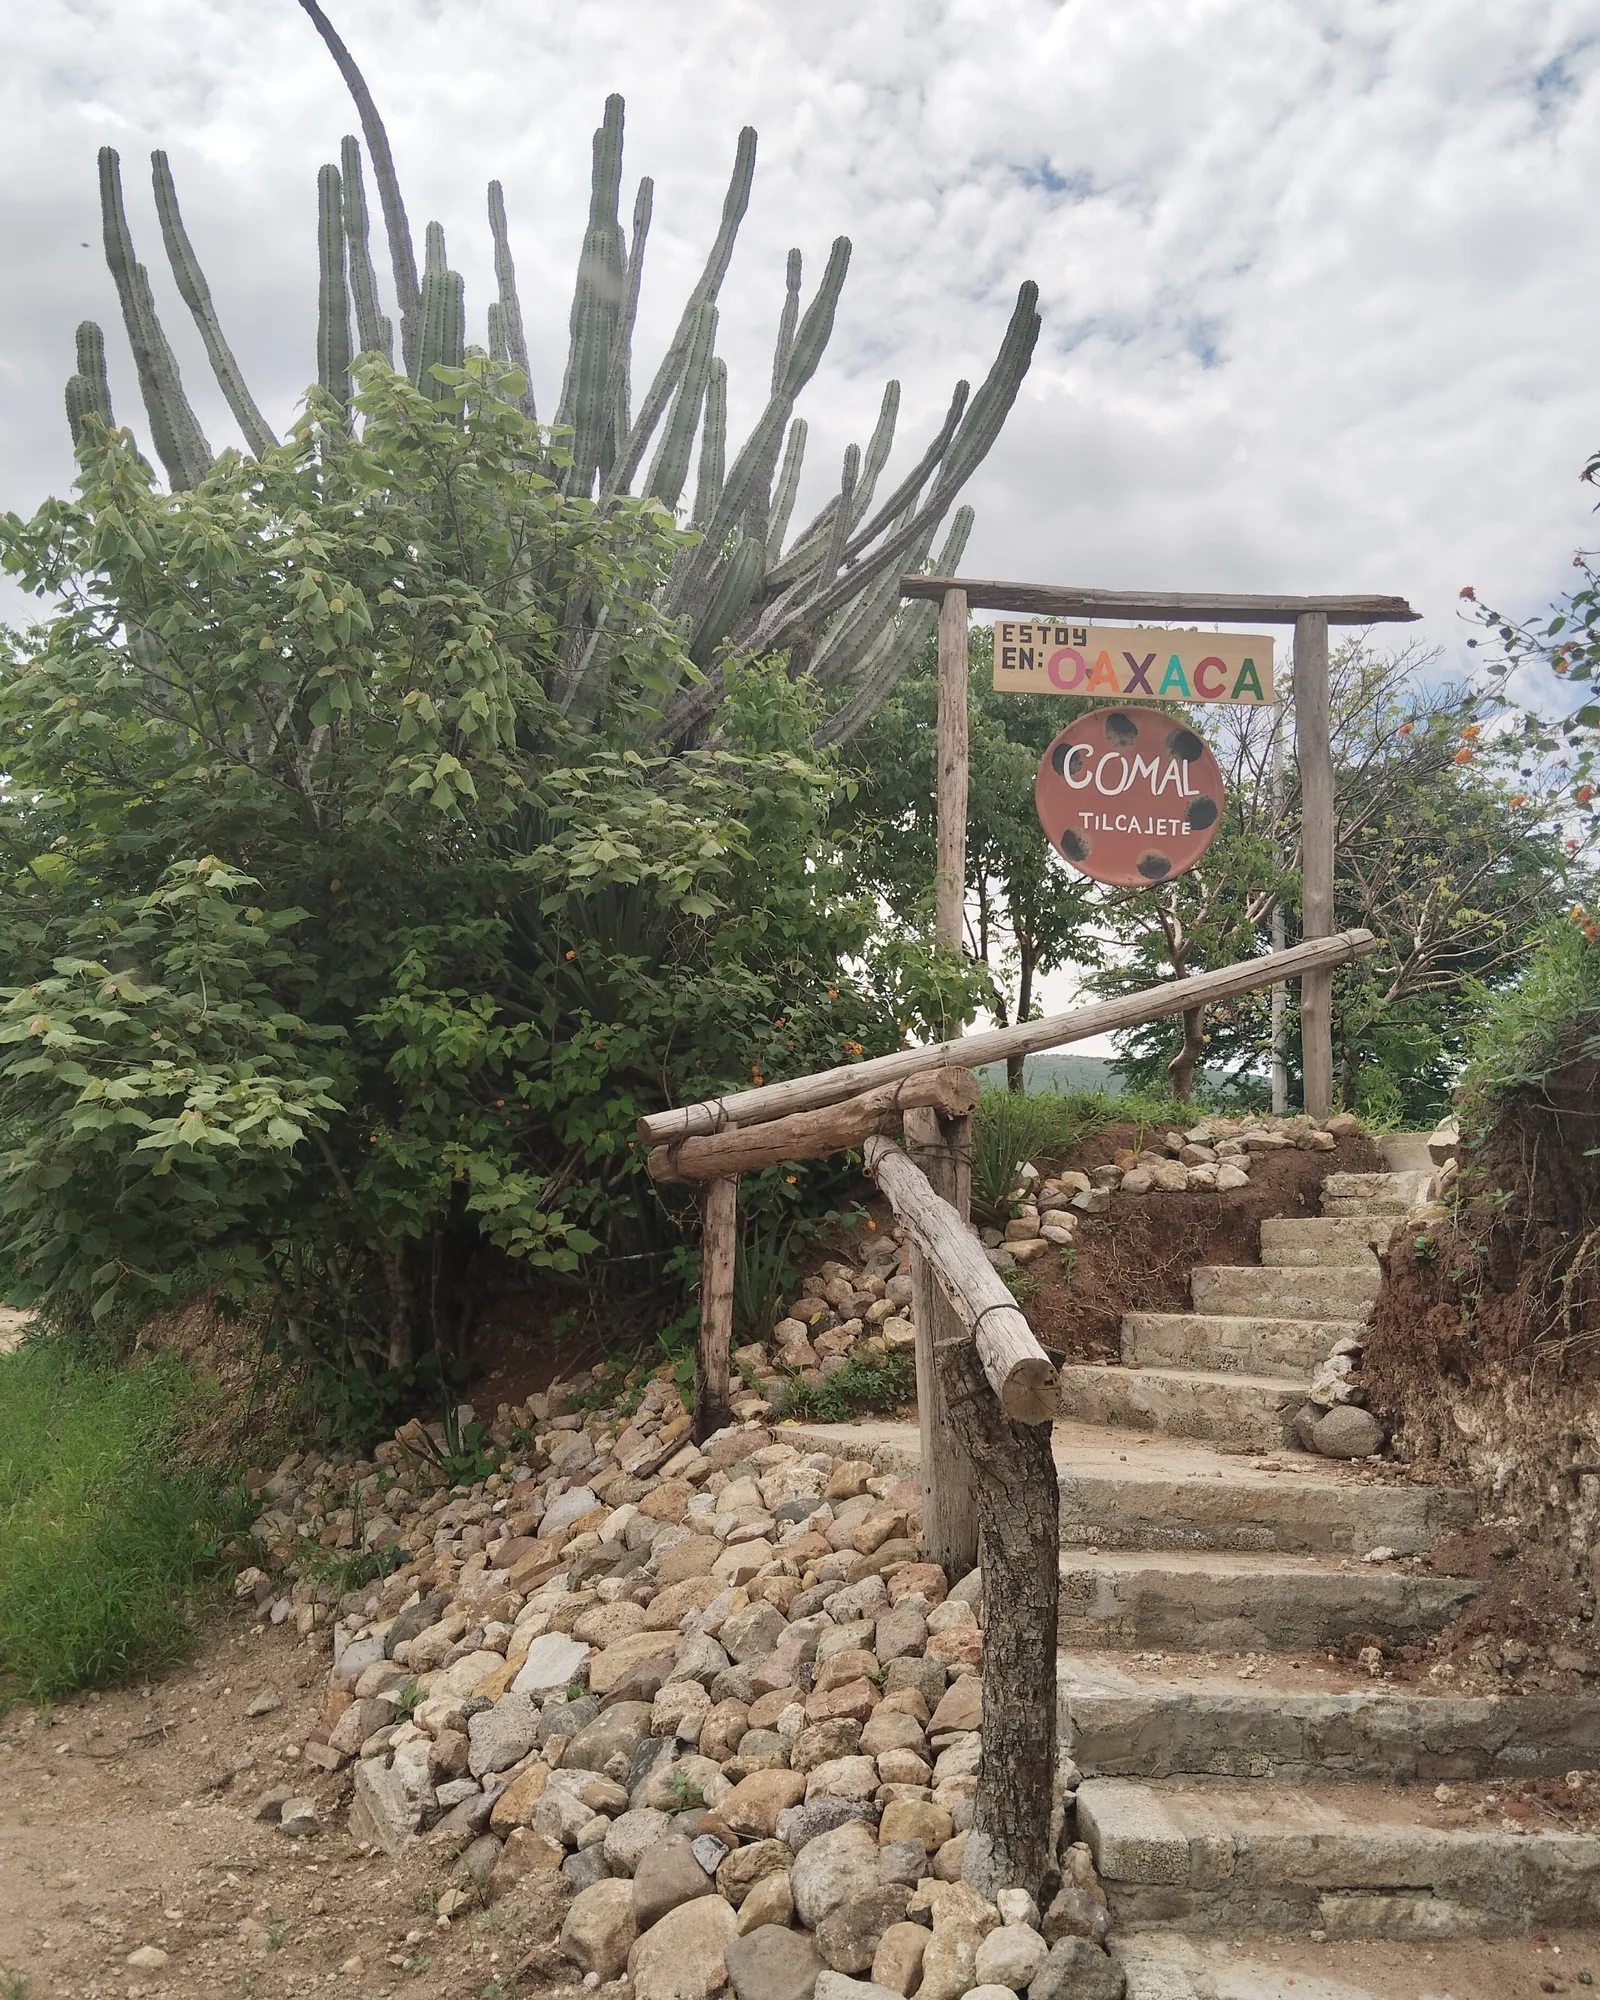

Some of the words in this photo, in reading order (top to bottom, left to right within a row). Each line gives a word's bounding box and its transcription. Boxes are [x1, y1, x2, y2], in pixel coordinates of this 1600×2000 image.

[1002, 624, 1087, 647] ESTOY
[1002, 647, 1043, 670] EN:
[1048, 648, 1264, 700] OAXACA
[1063, 744, 1200, 797] COMAL
[1078, 812, 1191, 836] TILCAJETE
